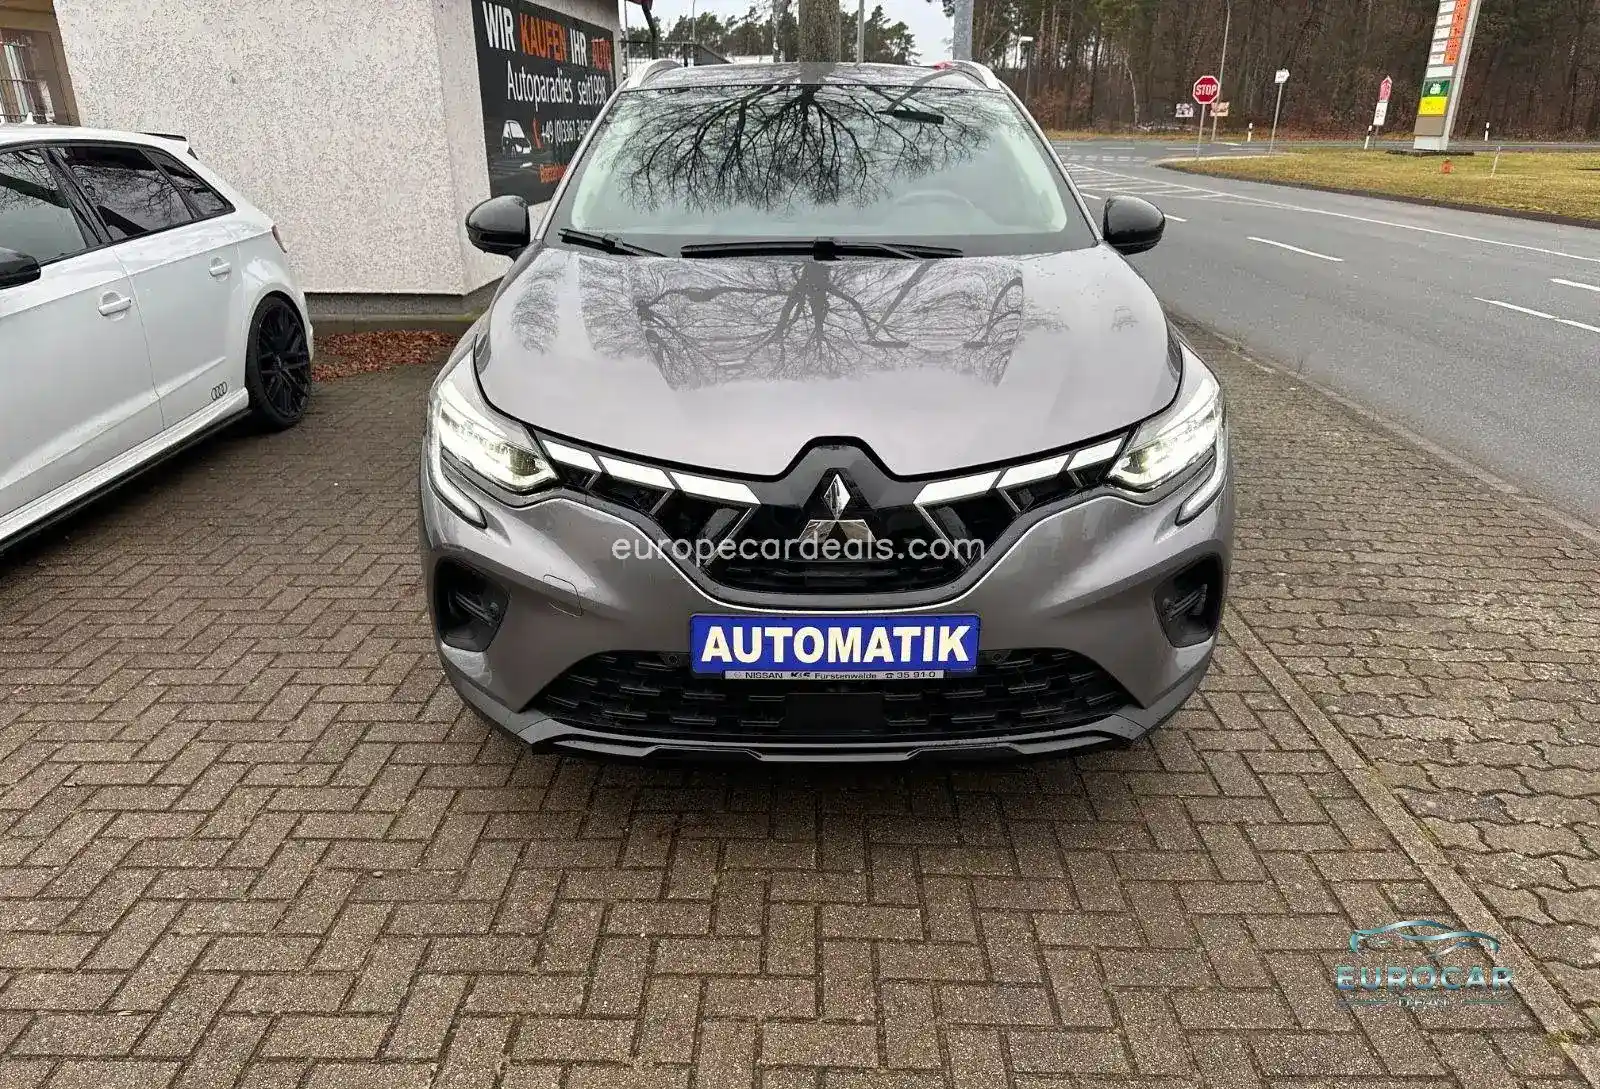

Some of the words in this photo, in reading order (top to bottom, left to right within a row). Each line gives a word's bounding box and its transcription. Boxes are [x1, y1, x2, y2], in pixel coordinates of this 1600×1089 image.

[482, 1, 516, 52] WIR
[520, 13, 567, 63] KAUFEN
[570, 28, 588, 67] IHR
[507, 60, 573, 112] Autoparadies
[1195, 84, 1217, 96] STOP
[700, 625, 971, 664] AUTOMATIK
[745, 671, 783, 679] NISSAN
